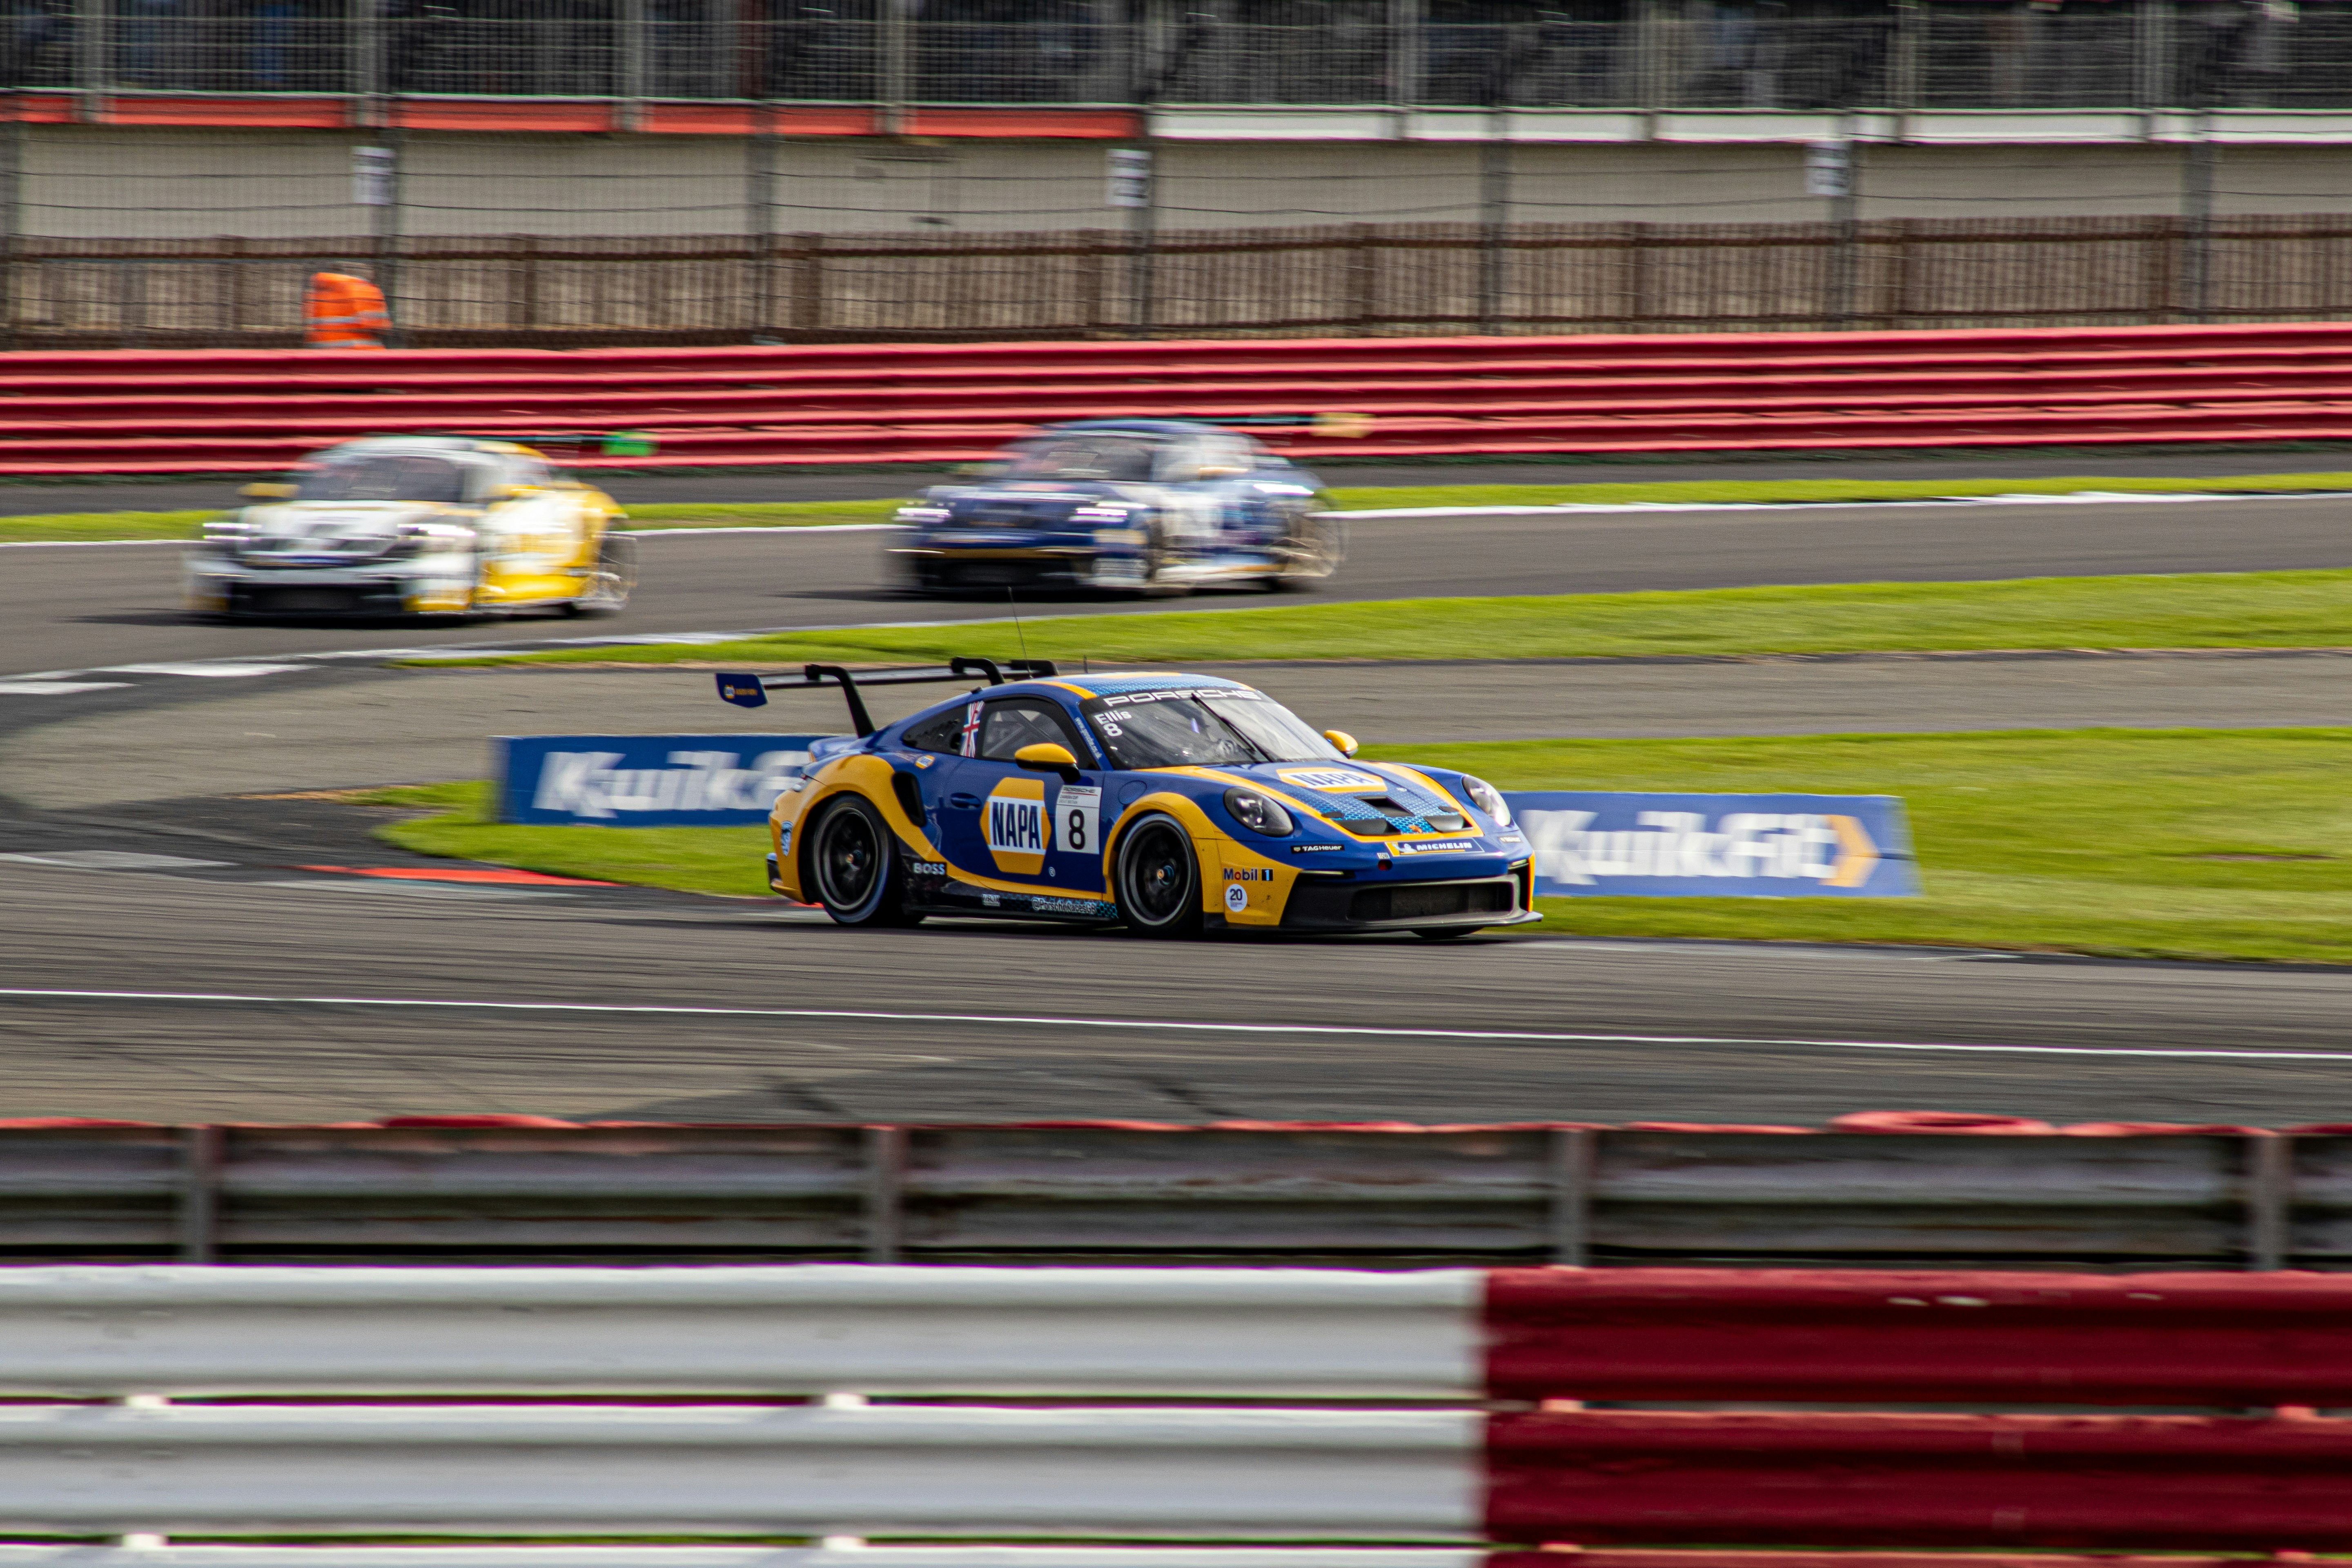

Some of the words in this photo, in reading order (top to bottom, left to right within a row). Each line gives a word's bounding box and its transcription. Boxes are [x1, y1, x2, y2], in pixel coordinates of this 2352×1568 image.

[1103, 690, 1262, 707] PORSCHE
[1094, 710, 1132, 725] Ellis
[1103, 723, 1123, 736] 8
[1292, 773, 1374, 786] NAPA
[992, 802, 1041, 849] NAPA
[1069, 809, 1085, 850] 8
[1417, 842, 1472, 851] MICHELIN
[913, 862, 945, 875] BOSS
[1224, 868, 1258, 881] Mobil
[1230, 889, 1243, 901] 20
